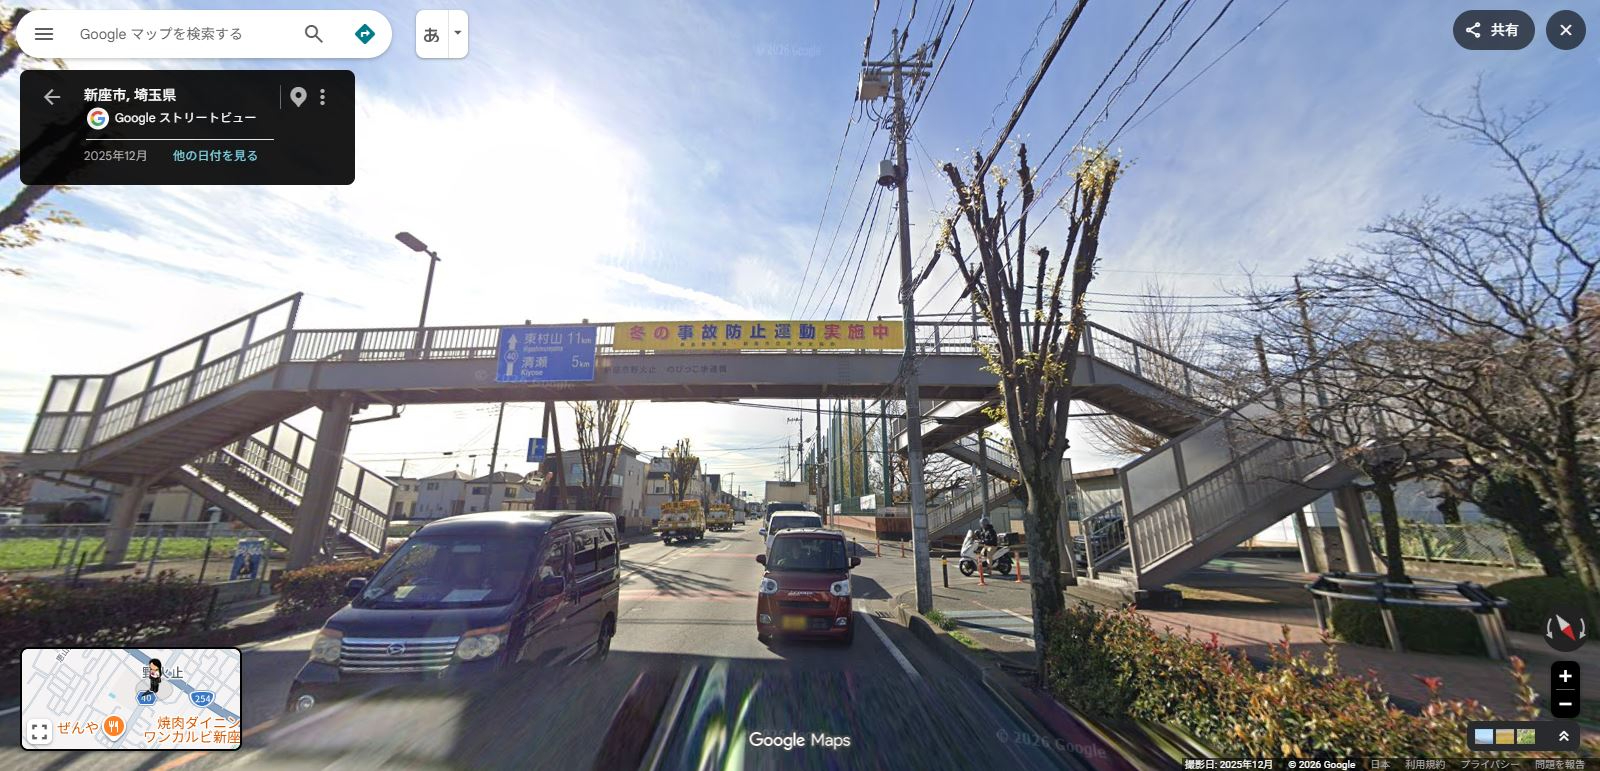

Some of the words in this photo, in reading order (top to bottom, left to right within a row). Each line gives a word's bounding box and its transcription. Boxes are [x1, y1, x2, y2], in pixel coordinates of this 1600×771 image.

[629, 323, 890, 341] 冬の事故防止運動実施中
[523, 333, 563, 345] 東村山
[521, 356, 548, 368] 清瀬
